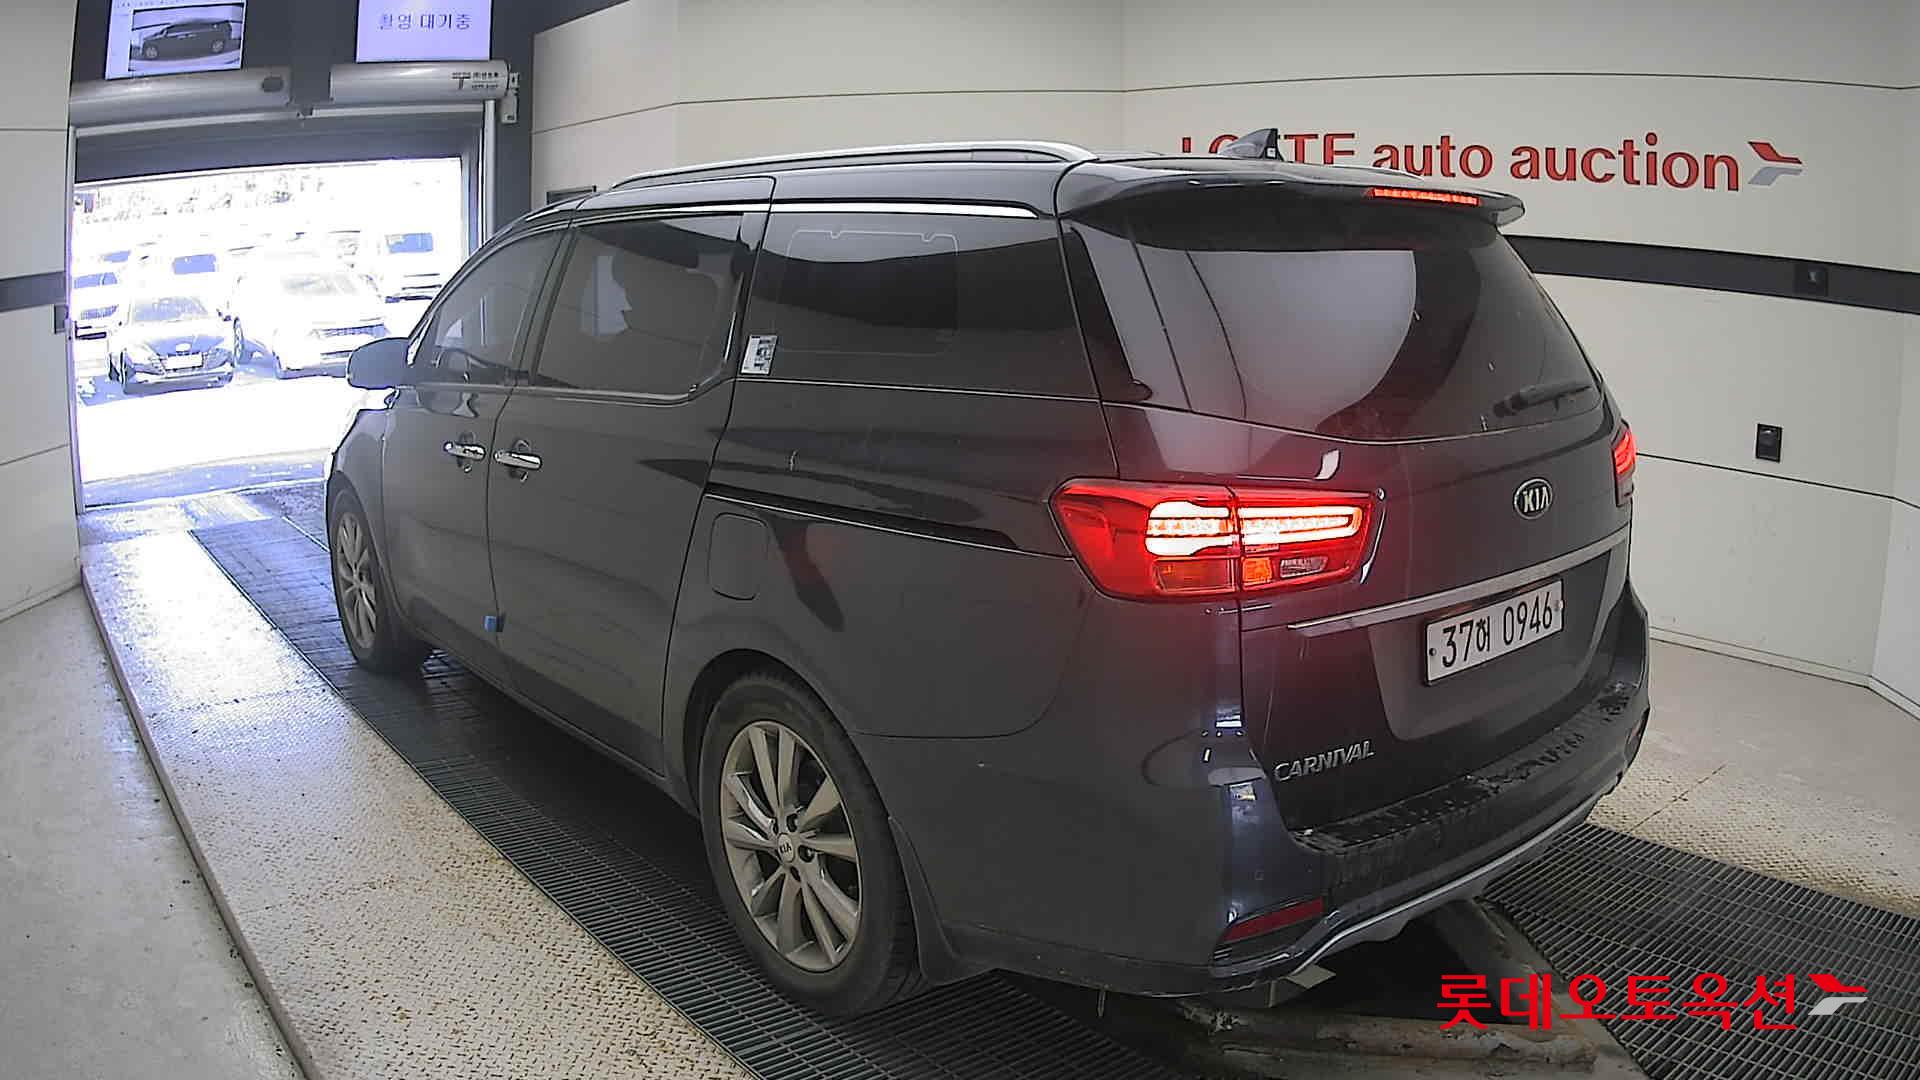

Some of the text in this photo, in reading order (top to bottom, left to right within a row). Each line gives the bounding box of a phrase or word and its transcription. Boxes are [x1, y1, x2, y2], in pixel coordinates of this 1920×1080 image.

[420, 13, 473, 31] 대기중
[1372, 135, 1493, 178] auto
[1510, 132, 1739, 191] auction
[1522, 486, 1550, 513] KIA
[1442, 591, 1553, 668] 37허 0946
[1273, 740, 1375, 781] CARNIVAL
